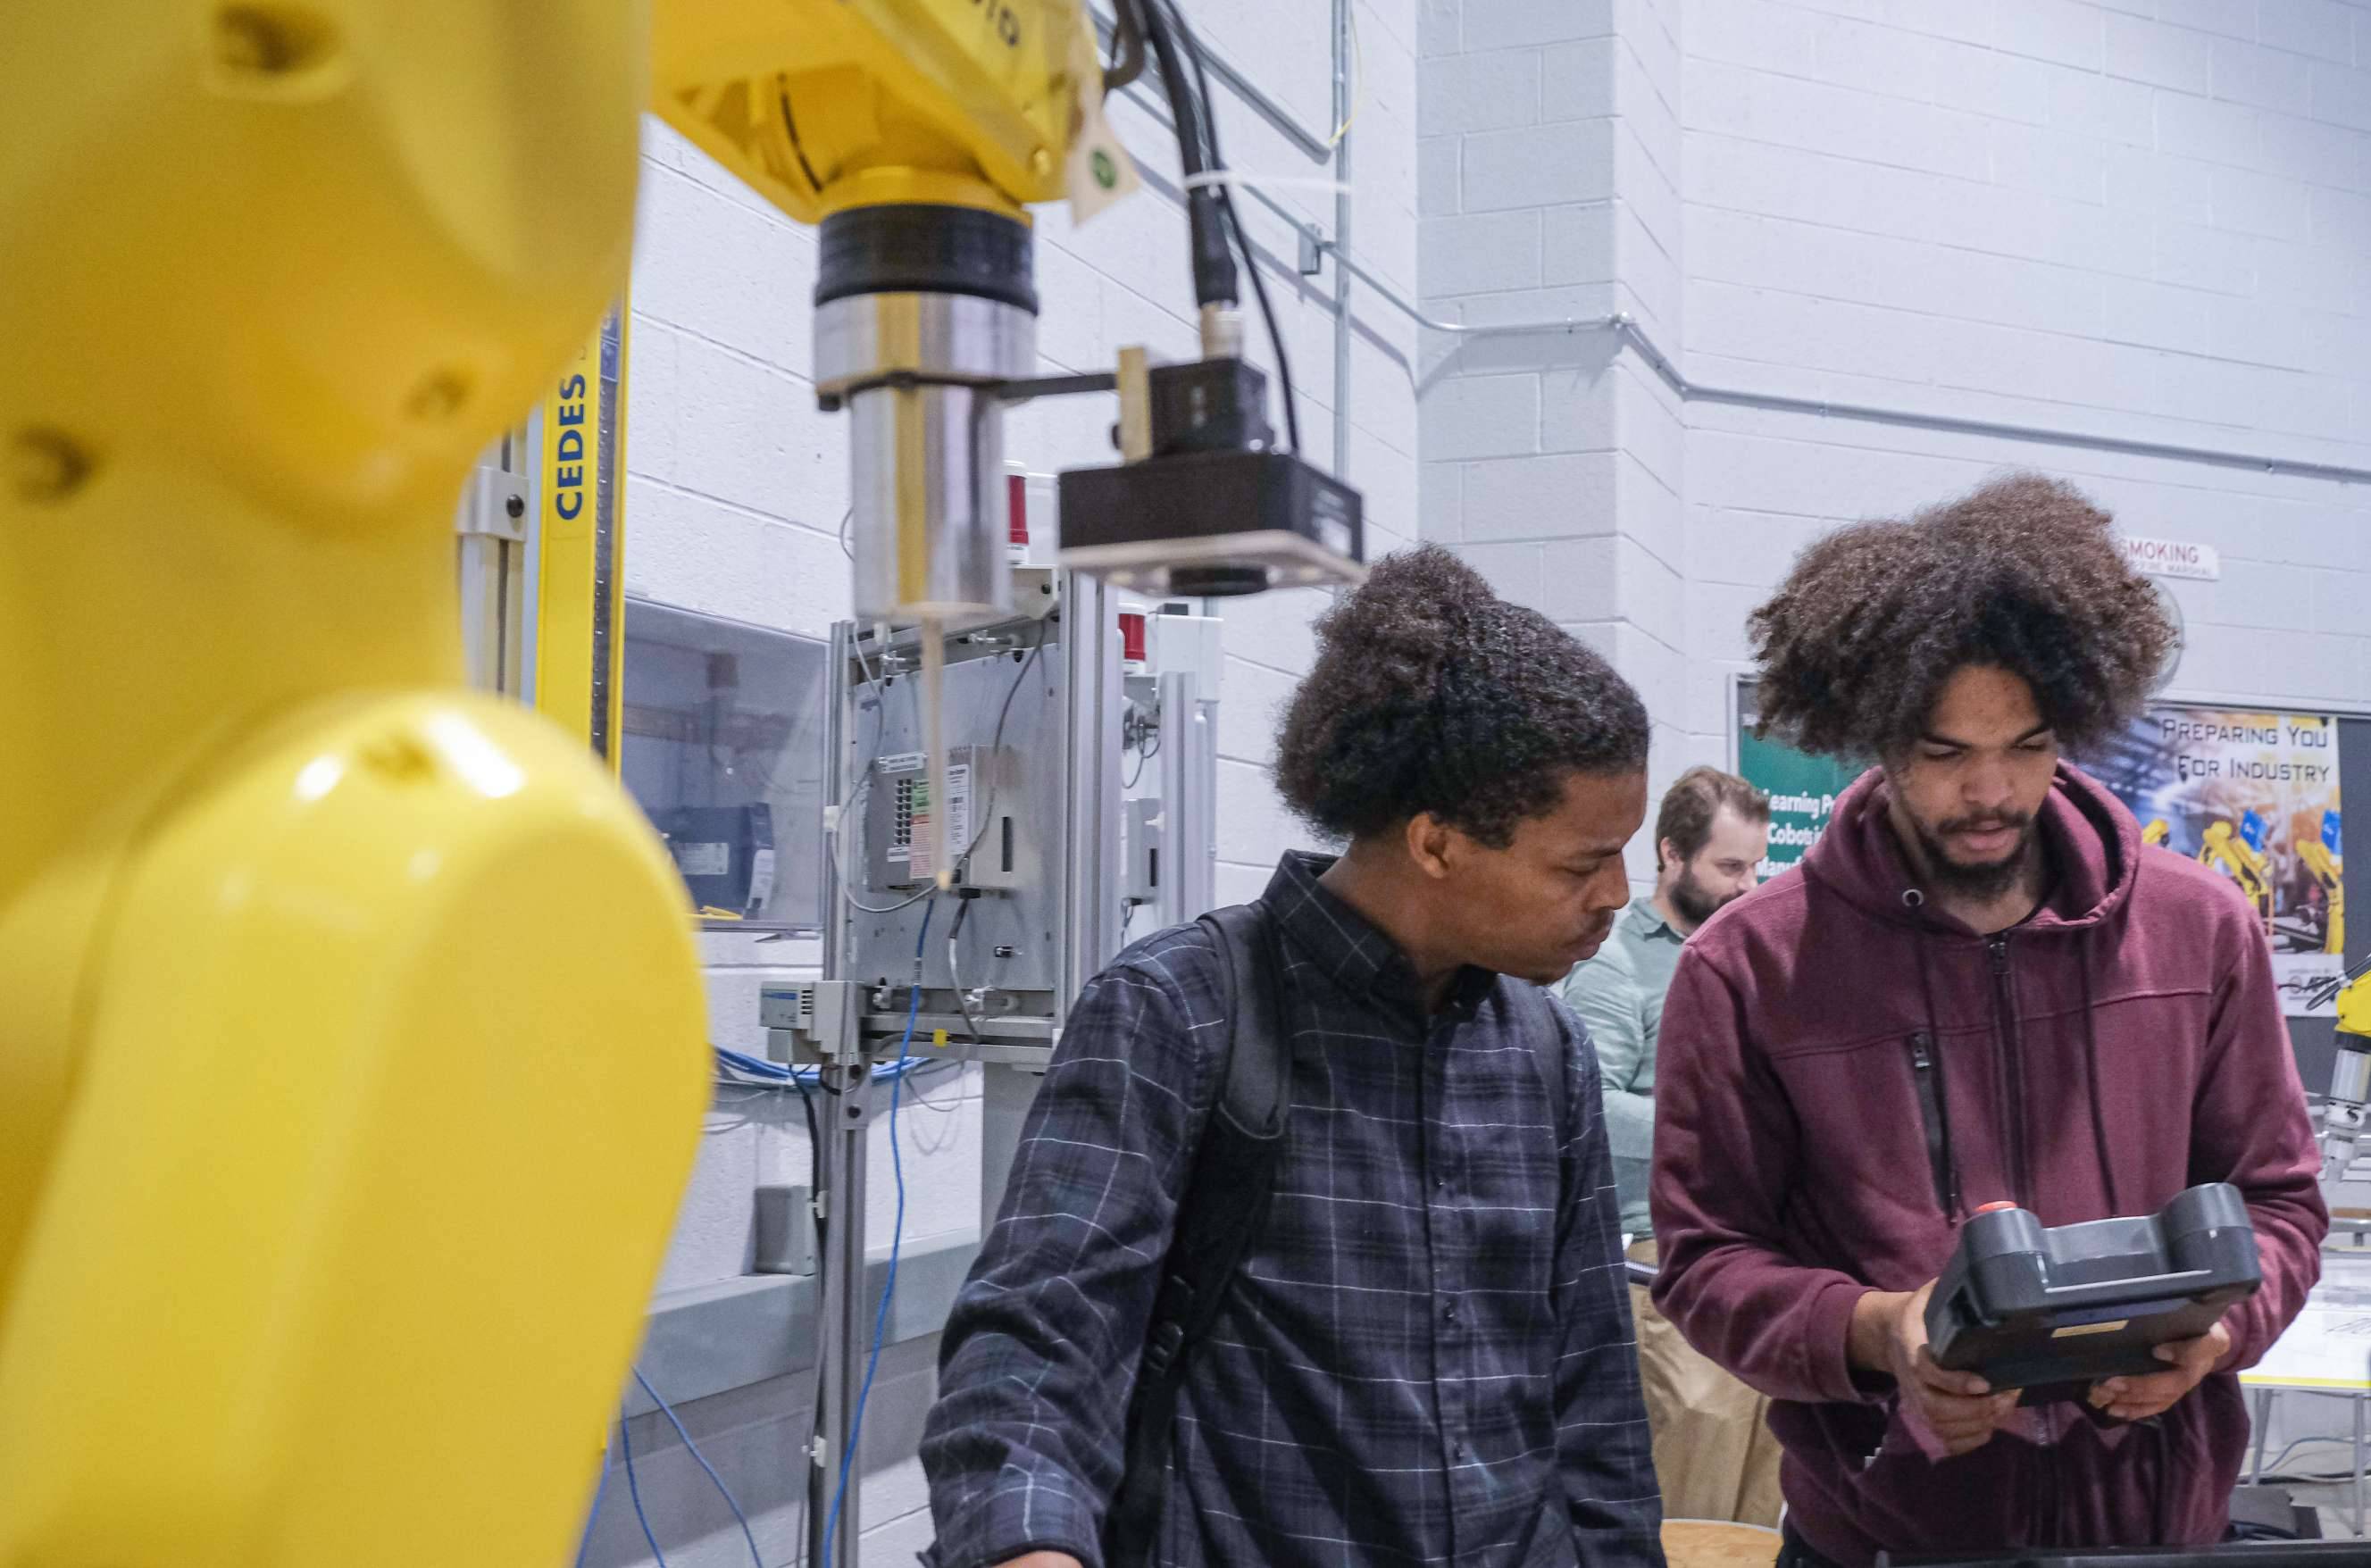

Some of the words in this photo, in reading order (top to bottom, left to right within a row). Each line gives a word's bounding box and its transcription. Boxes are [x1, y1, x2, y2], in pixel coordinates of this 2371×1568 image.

[556, 373, 586, 520] CEDES
[2163, 719, 2277, 745] PREPARING
[2178, 755, 2219, 777] FOR
[2230, 758, 2329, 782] INDUSTRY
[1767, 822, 1813, 846] Cobots
